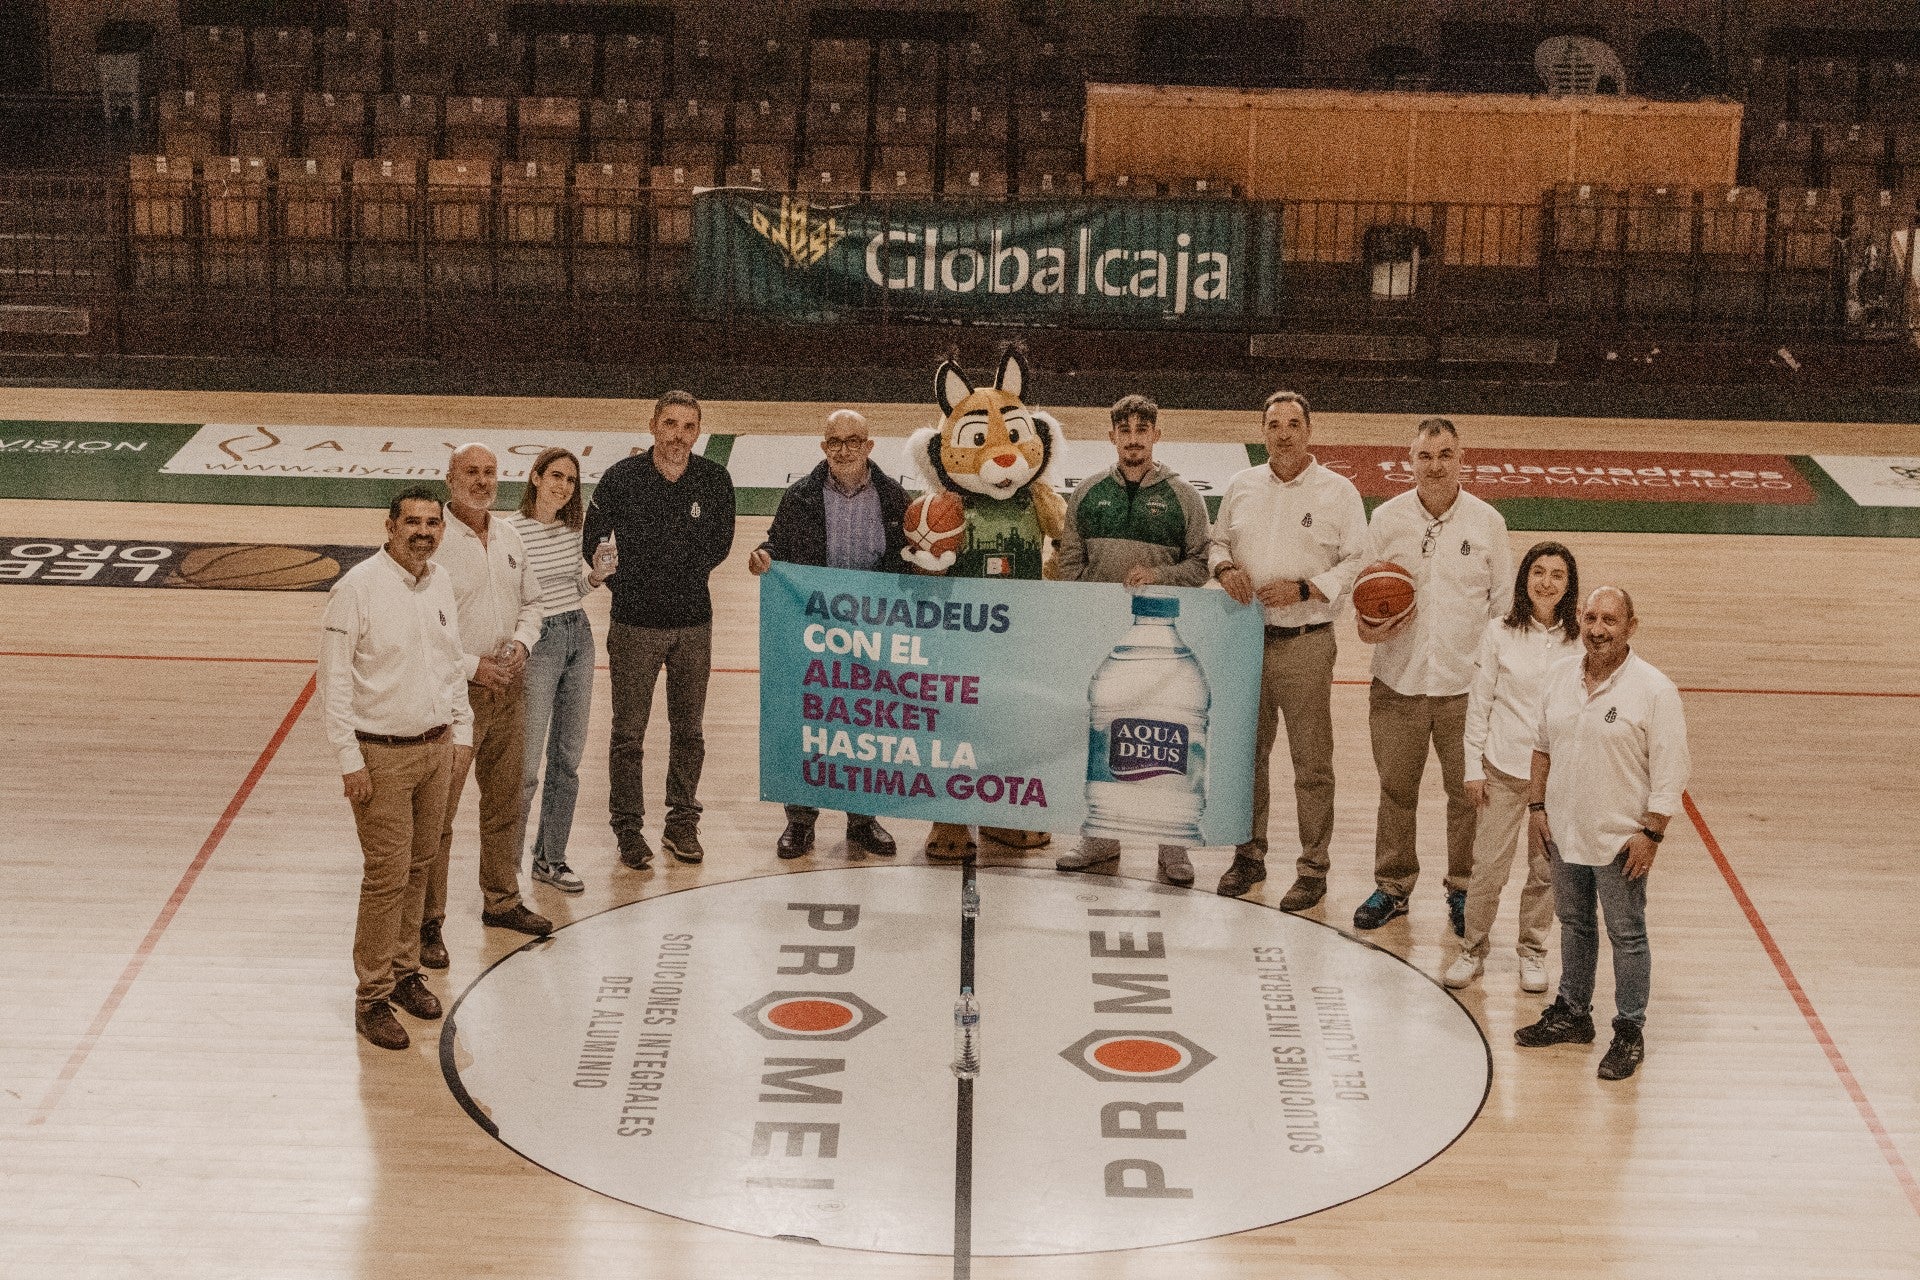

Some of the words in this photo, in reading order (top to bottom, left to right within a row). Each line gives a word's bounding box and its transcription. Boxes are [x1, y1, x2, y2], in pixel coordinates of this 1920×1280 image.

[865, 227, 1230, 315] Globalcaja
[1544, 475, 1792, 490] MANCHEGO
[10, 543, 173, 562] ORO
[804, 590, 1011, 634] AQUADEUS
[803, 623, 882, 662] CON
[890, 633, 929, 666] EL
[802, 659, 981, 705] ALBACETE
[802, 692, 941, 732] BASKET
[1117, 723, 1184, 745] AQUA
[802, 725, 922, 767] HASTA
[931, 739, 978, 770] LA
[1118, 742, 1181, 763] DEUS
[802, 752, 937, 798] ÚLTIMA
[945, 774, 1049, 808] GOTA
[596, 975, 634, 1003] DEL
[643, 933, 694, 1025] SOLUCIONES
[1252, 946, 1302, 1039] INTEGRALES
[1311, 986, 1362, 1064] ALUMINIO
[572, 1009, 625, 1089] ALUMINIO
[616, 1032, 673, 1138] INTEGRALES
[1272, 1046, 1325, 1154] SOLUCIONES
[1330, 1071, 1370, 1101] DEL
